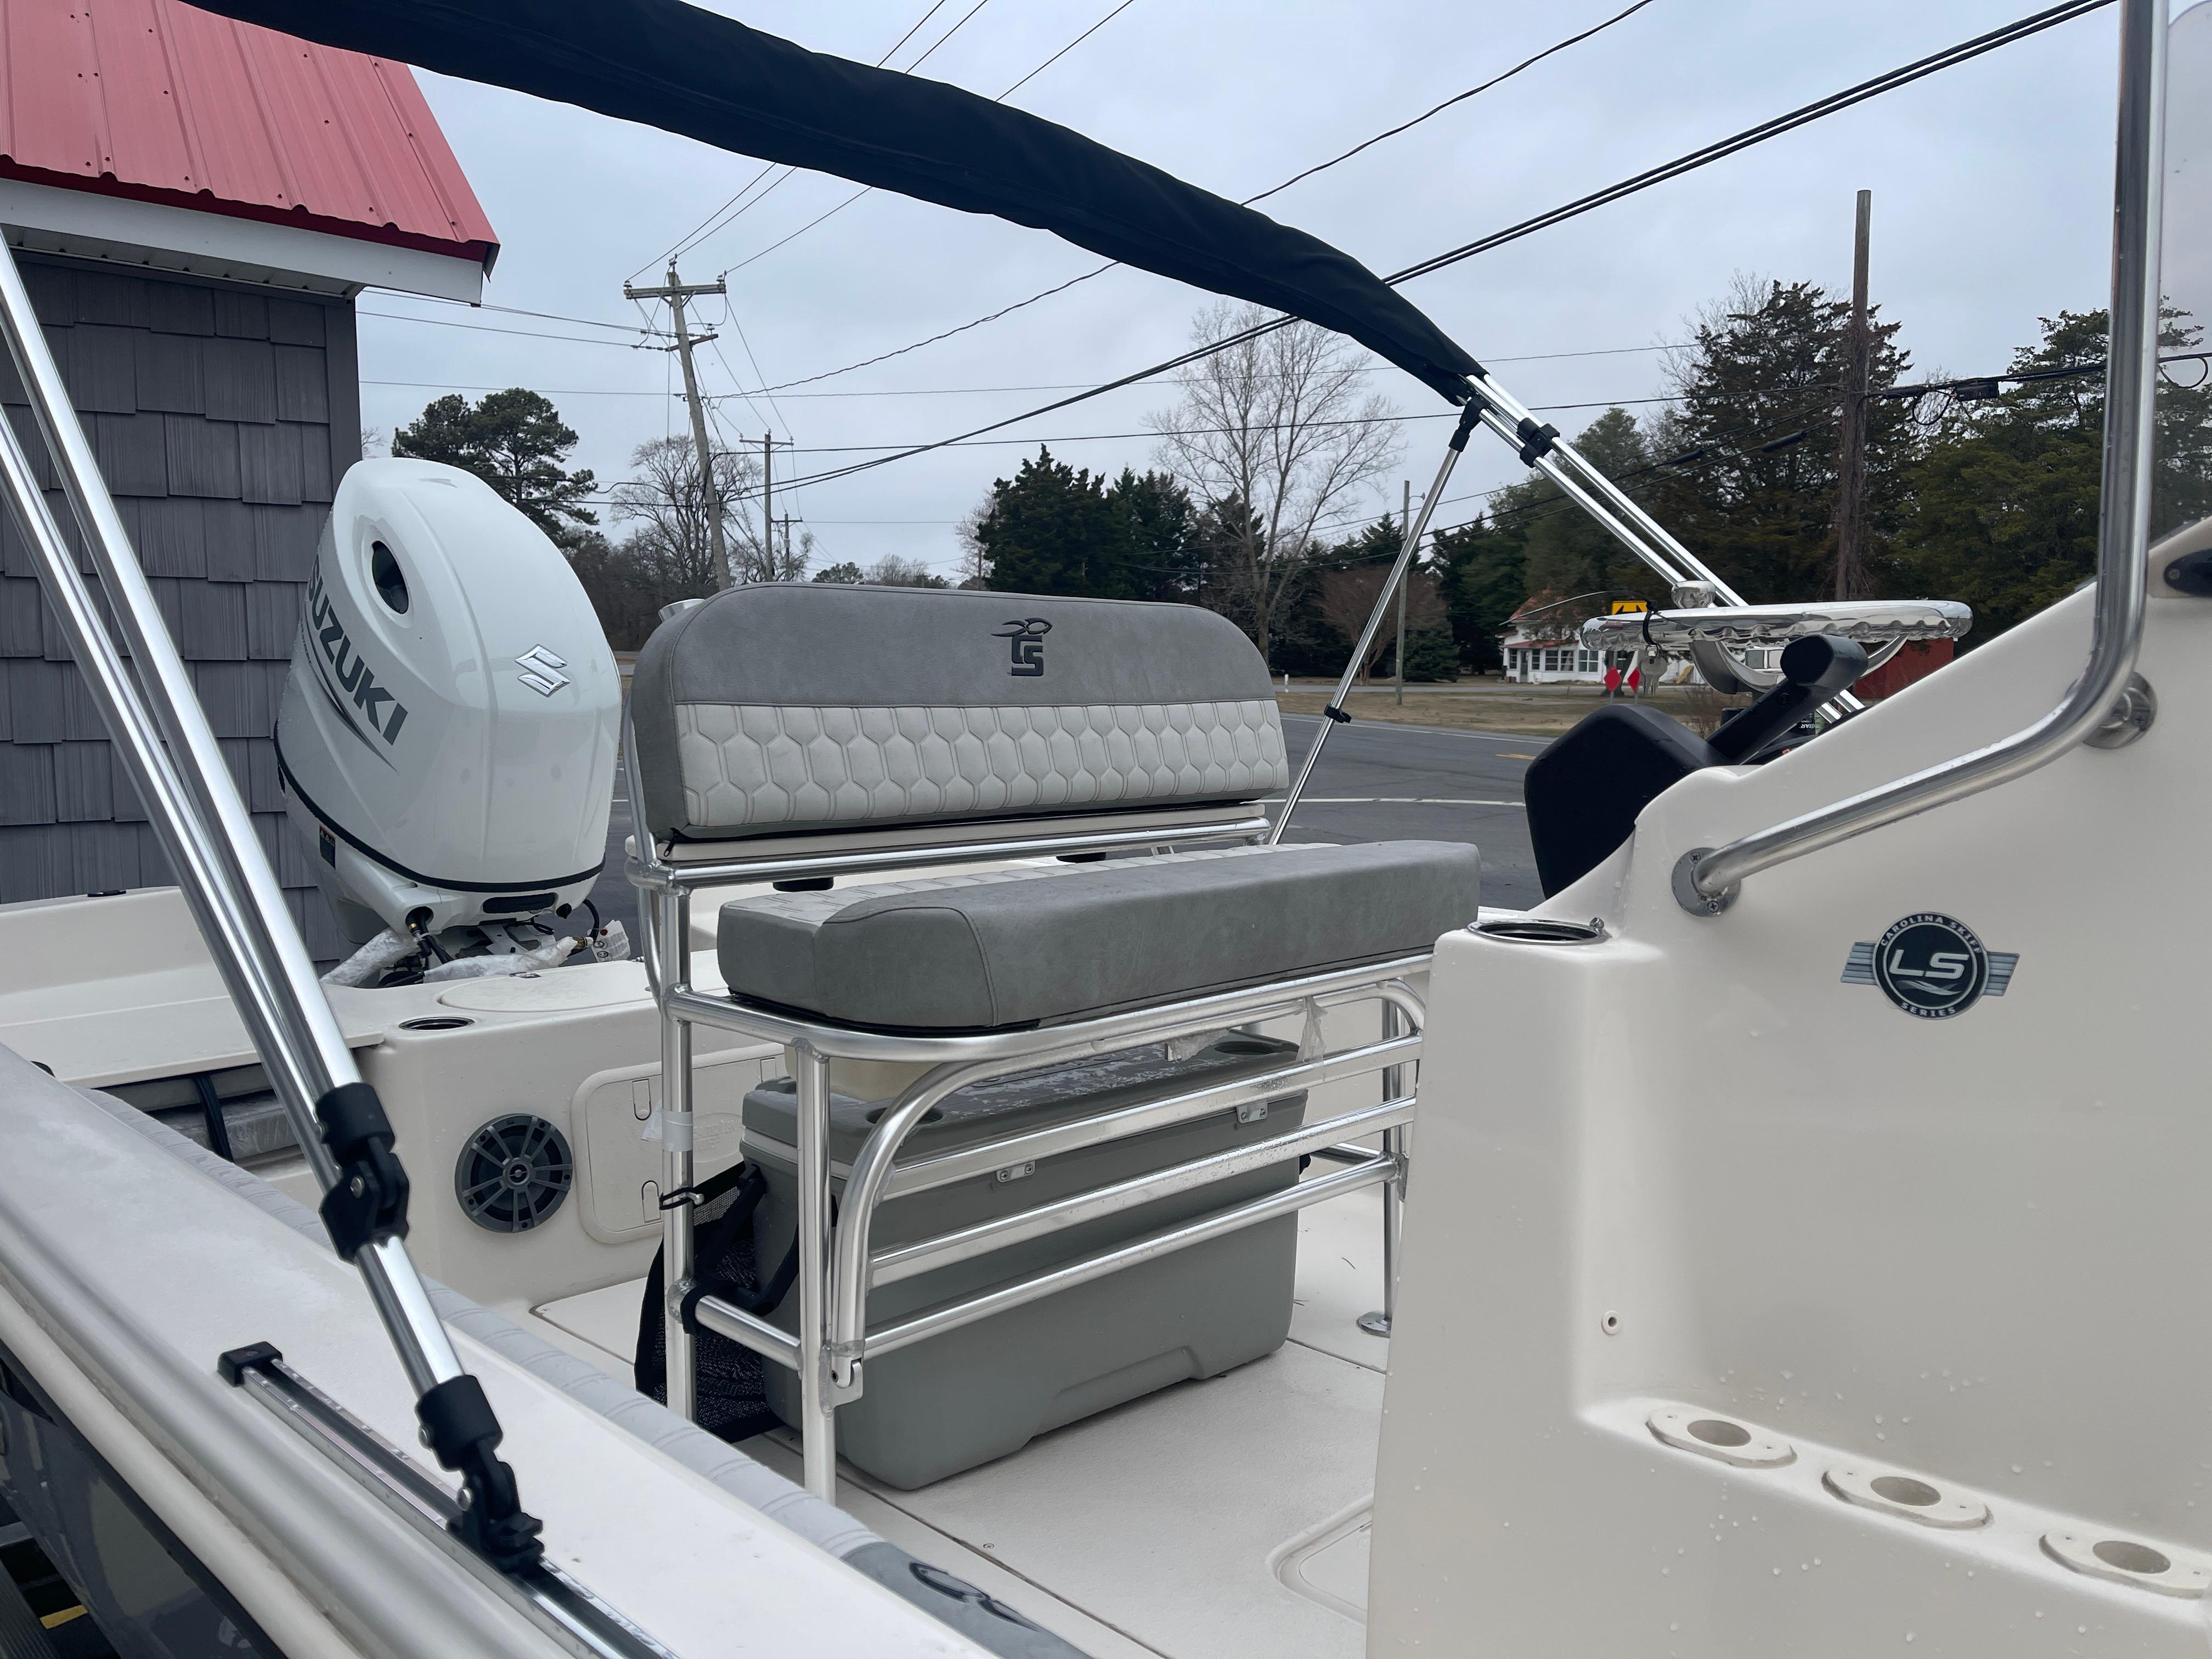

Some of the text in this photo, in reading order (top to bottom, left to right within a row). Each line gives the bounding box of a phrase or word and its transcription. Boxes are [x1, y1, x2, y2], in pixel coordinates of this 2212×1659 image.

[308, 553, 408, 746] SUZUKI
[1880, 915, 1944, 946] CAROLINA
[1889, 949, 1970, 979] LS
[1901, 1002, 1957, 1018] SERIES
